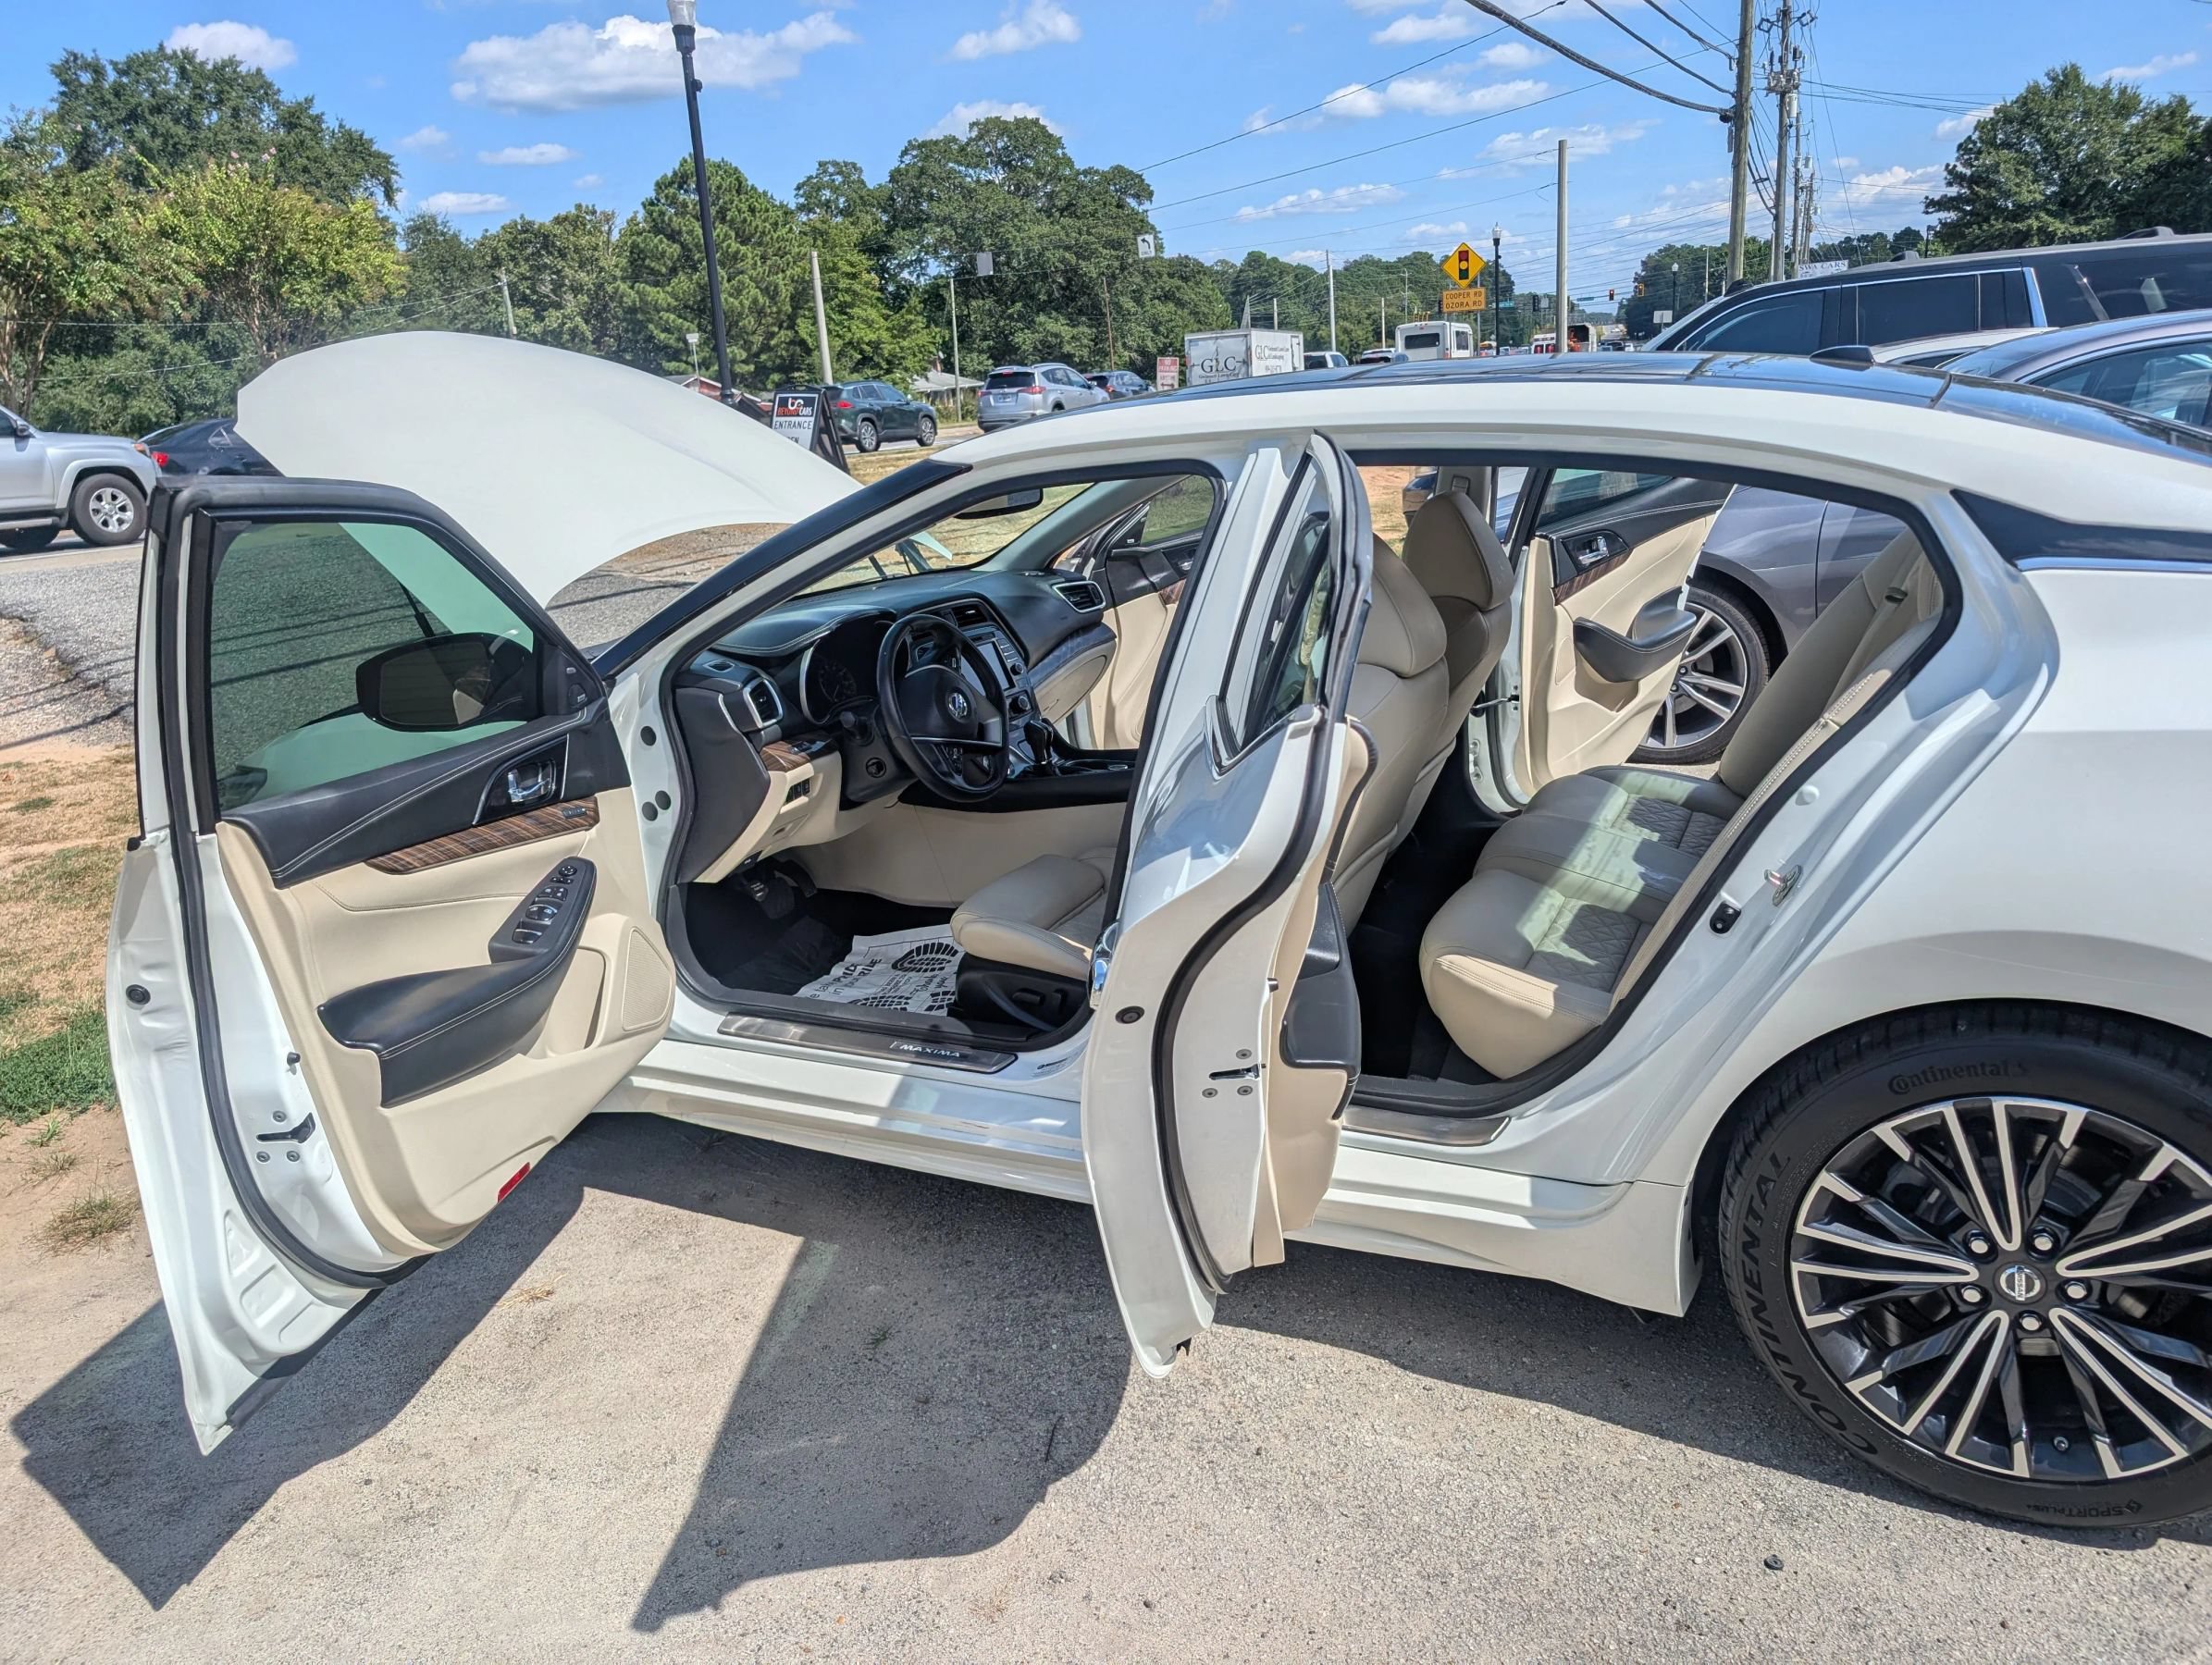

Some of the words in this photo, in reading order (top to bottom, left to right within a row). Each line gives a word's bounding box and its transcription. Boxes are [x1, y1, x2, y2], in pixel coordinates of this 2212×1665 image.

[1445, 291, 1471, 300] COOPER
[1445, 301, 1470, 309] OZORA
[1255, 344, 1268, 360] GLC
[1201, 356, 1237, 373] GLC
[798, 407, 812, 415] CARS
[773, 420, 812, 430] ENTRANCE
[899, 1043, 960, 1058] MAXIMA
[1887, 1060, 2009, 1095] Continental
[1742, 1152, 1878, 1455] CONTINENTAL
